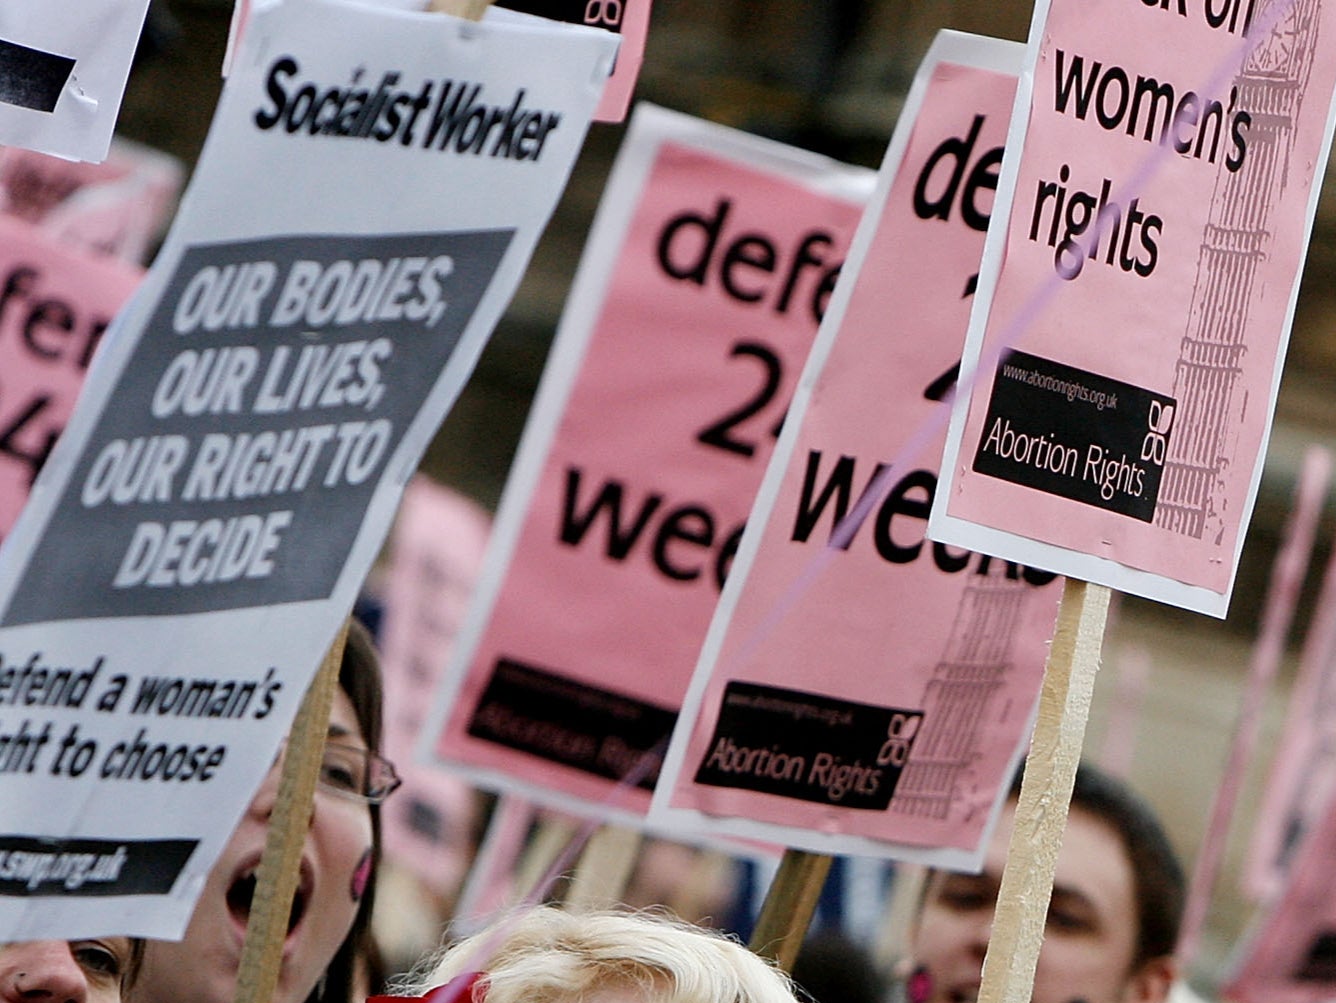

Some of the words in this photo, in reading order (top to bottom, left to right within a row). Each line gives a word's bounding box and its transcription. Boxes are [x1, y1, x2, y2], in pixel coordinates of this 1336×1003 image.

[255, 57, 432, 148] Socialist
[423, 79, 563, 163] Worker
[1055, 49, 1252, 173] women's
[1028, 164, 1163, 281] rights
[173, 261, 277, 334] OUR
[269, 256, 454, 328] BODIES,
[152, 346, 259, 419] OUR
[252, 338, 393, 411] LIVES,
[81, 435, 189, 508] OUR
[181, 425, 335, 500] RIGHT
[324, 419, 392, 488] TO
[983, 417, 1078, 478] Abortion
[1082, 444, 1147, 500] Rights
[112, 511, 294, 588] DECIDE
[0, 653, 104, 709] efend
[97, 673, 128, 713] a
[130, 667, 283, 720] woman's
[51, 723, 97, 778] to
[98, 728, 228, 782] choose
[705, 737, 805, 783] Abortion
[808, 752, 882, 801] Rights
